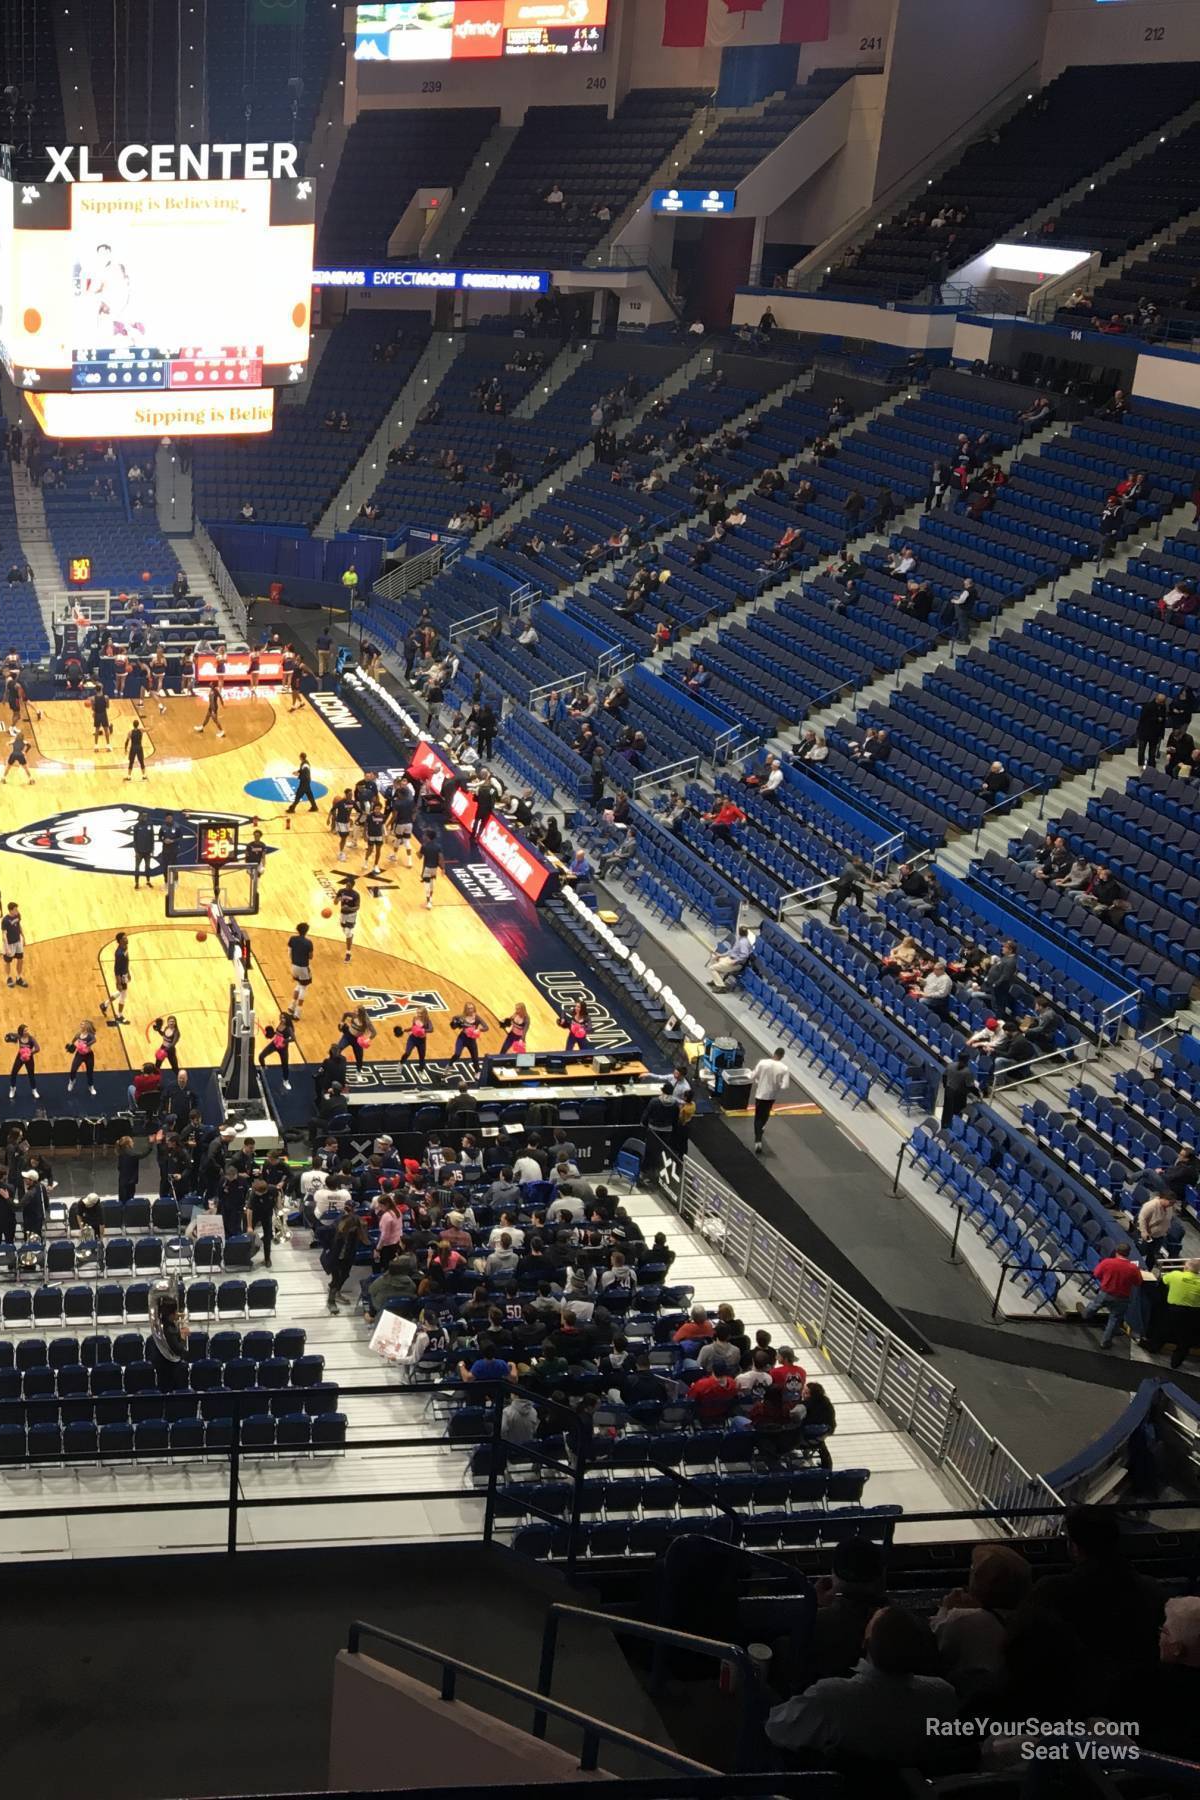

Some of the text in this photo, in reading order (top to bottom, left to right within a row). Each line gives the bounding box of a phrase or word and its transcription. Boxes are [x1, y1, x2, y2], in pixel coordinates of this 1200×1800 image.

[454, 20, 502, 39] xfinity
[1144, 27, 1165, 41] 212
[860, 36, 882, 50] 241
[421, 81, 442, 93] 239
[586, 77, 606, 89] 240
[45, 142, 298, 182] XL CENTER
[81, 197, 142, 213] Sipping
[148, 197, 160, 210] is
[134, 407, 205, 426] Sipping
[211, 406, 225, 421] is
[308, 692, 362, 729] UCONN
[452, 868, 487, 898] HEALTH
[467, 863, 517, 901] UCONN
[506, 1304, 522, 1319] 50
[429, 1337, 445, 1352] 34
